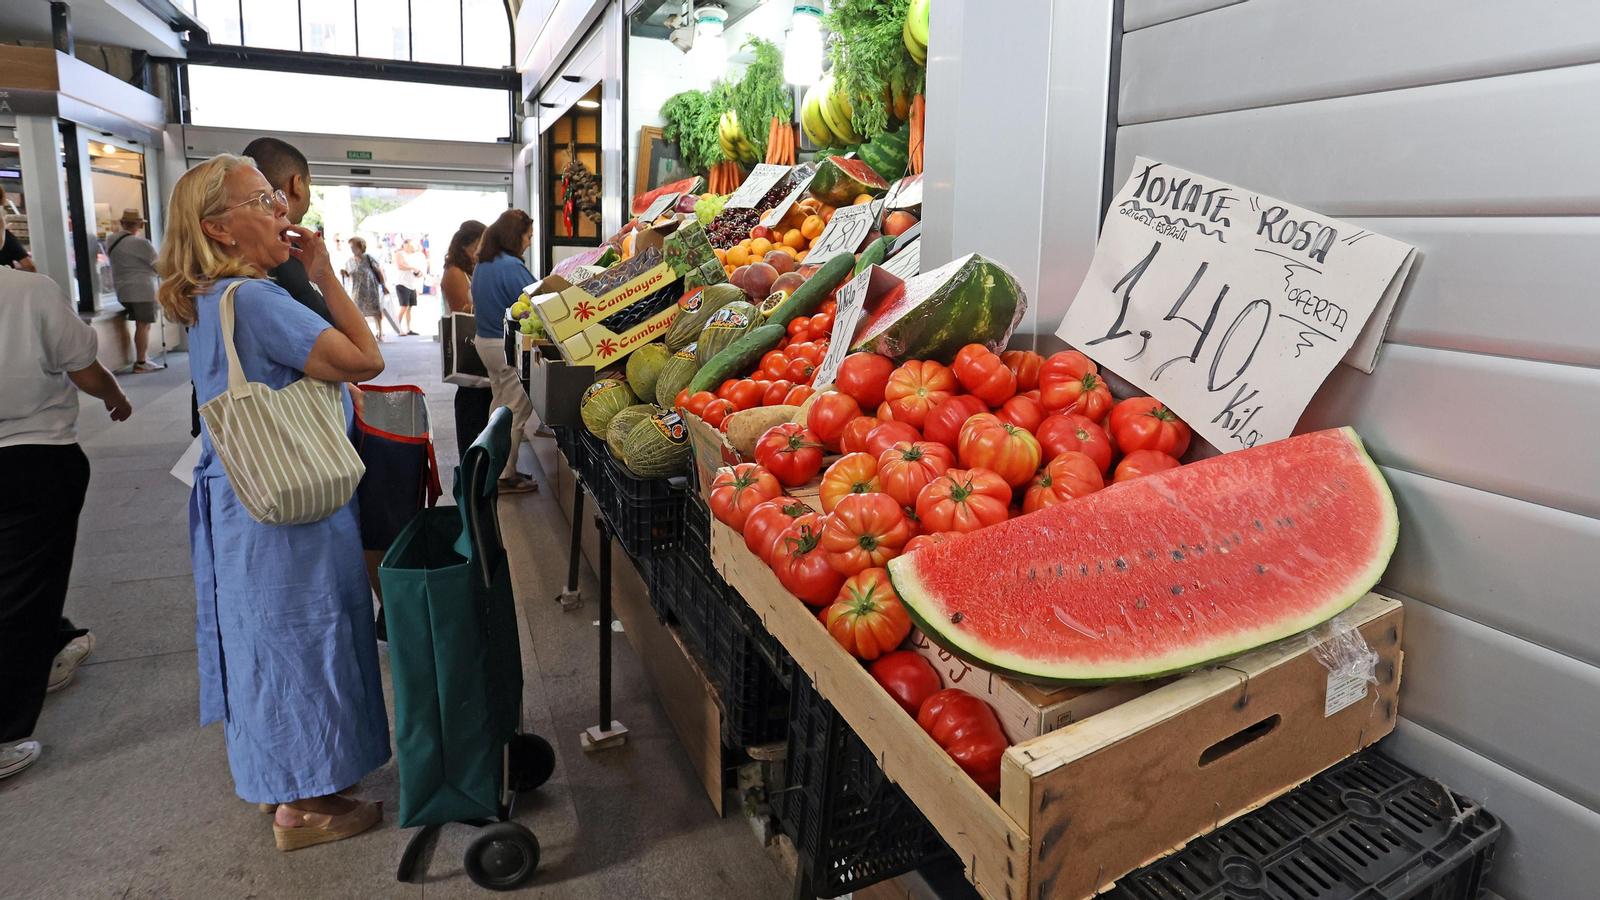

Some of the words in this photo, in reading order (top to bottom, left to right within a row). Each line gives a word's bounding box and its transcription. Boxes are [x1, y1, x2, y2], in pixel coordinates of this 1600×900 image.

[348, 151, 370, 159] SALIDA
[1133, 162, 1240, 228] TOMATE
[597, 271, 663, 311] Cambayas
[1286, 287, 1348, 332] OFERTA
[619, 312, 676, 348] Cambaya
[1085, 240, 1271, 392] 1,40
[1211, 382, 1264, 449] Kilo
